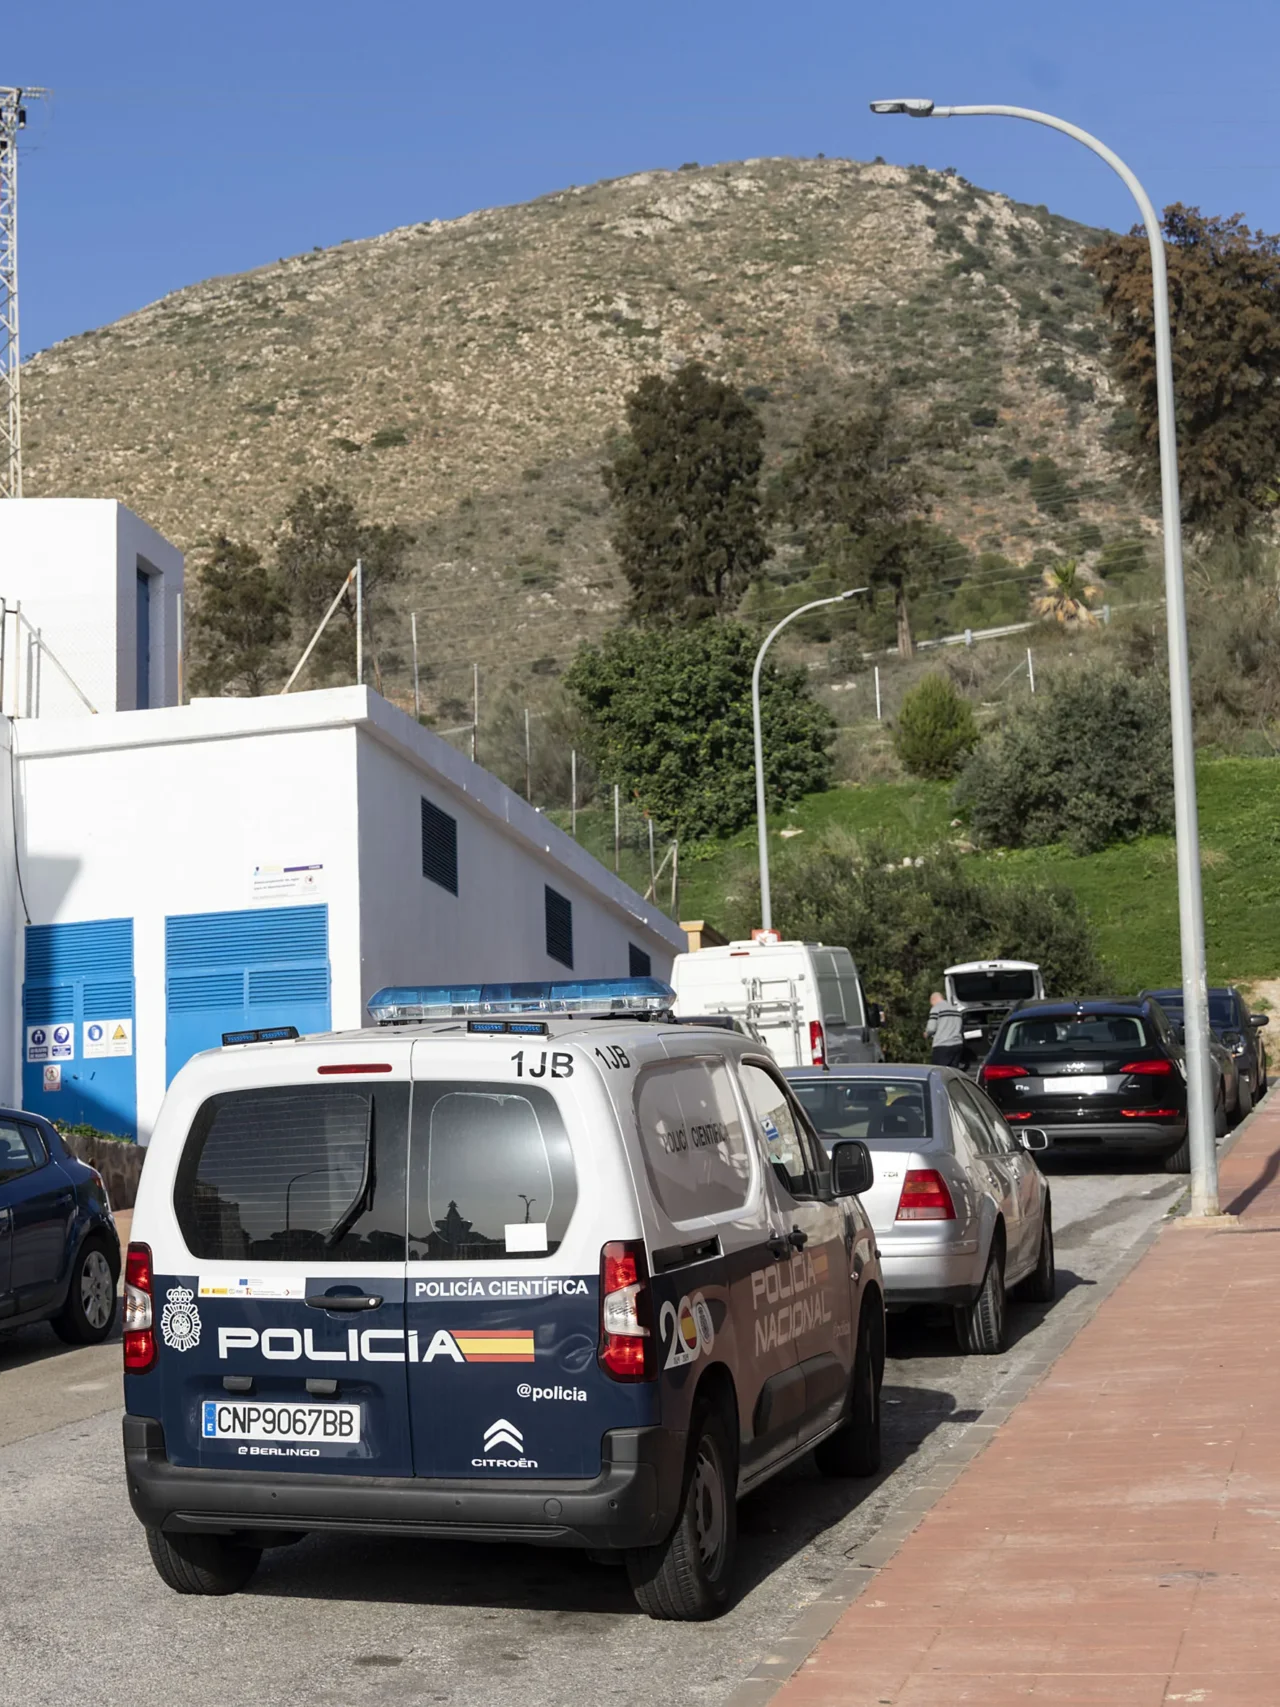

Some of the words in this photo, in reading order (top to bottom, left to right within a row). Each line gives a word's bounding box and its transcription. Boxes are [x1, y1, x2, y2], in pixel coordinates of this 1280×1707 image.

[510, 1050, 575, 1079] 1JB
[594, 1044, 632, 1070] 1JB
[415, 1278, 486, 1297] POLICÍA
[488, 1276, 590, 1296] CIENTÍFICA
[753, 1290, 832, 1357] NACIONAL
[516, 1383, 588, 1402] @policia
[206, 1423, 214, 1432] E
[217, 1406, 355, 1437] CNP9067BB
[249, 1446, 320, 1457] BERLINGO
